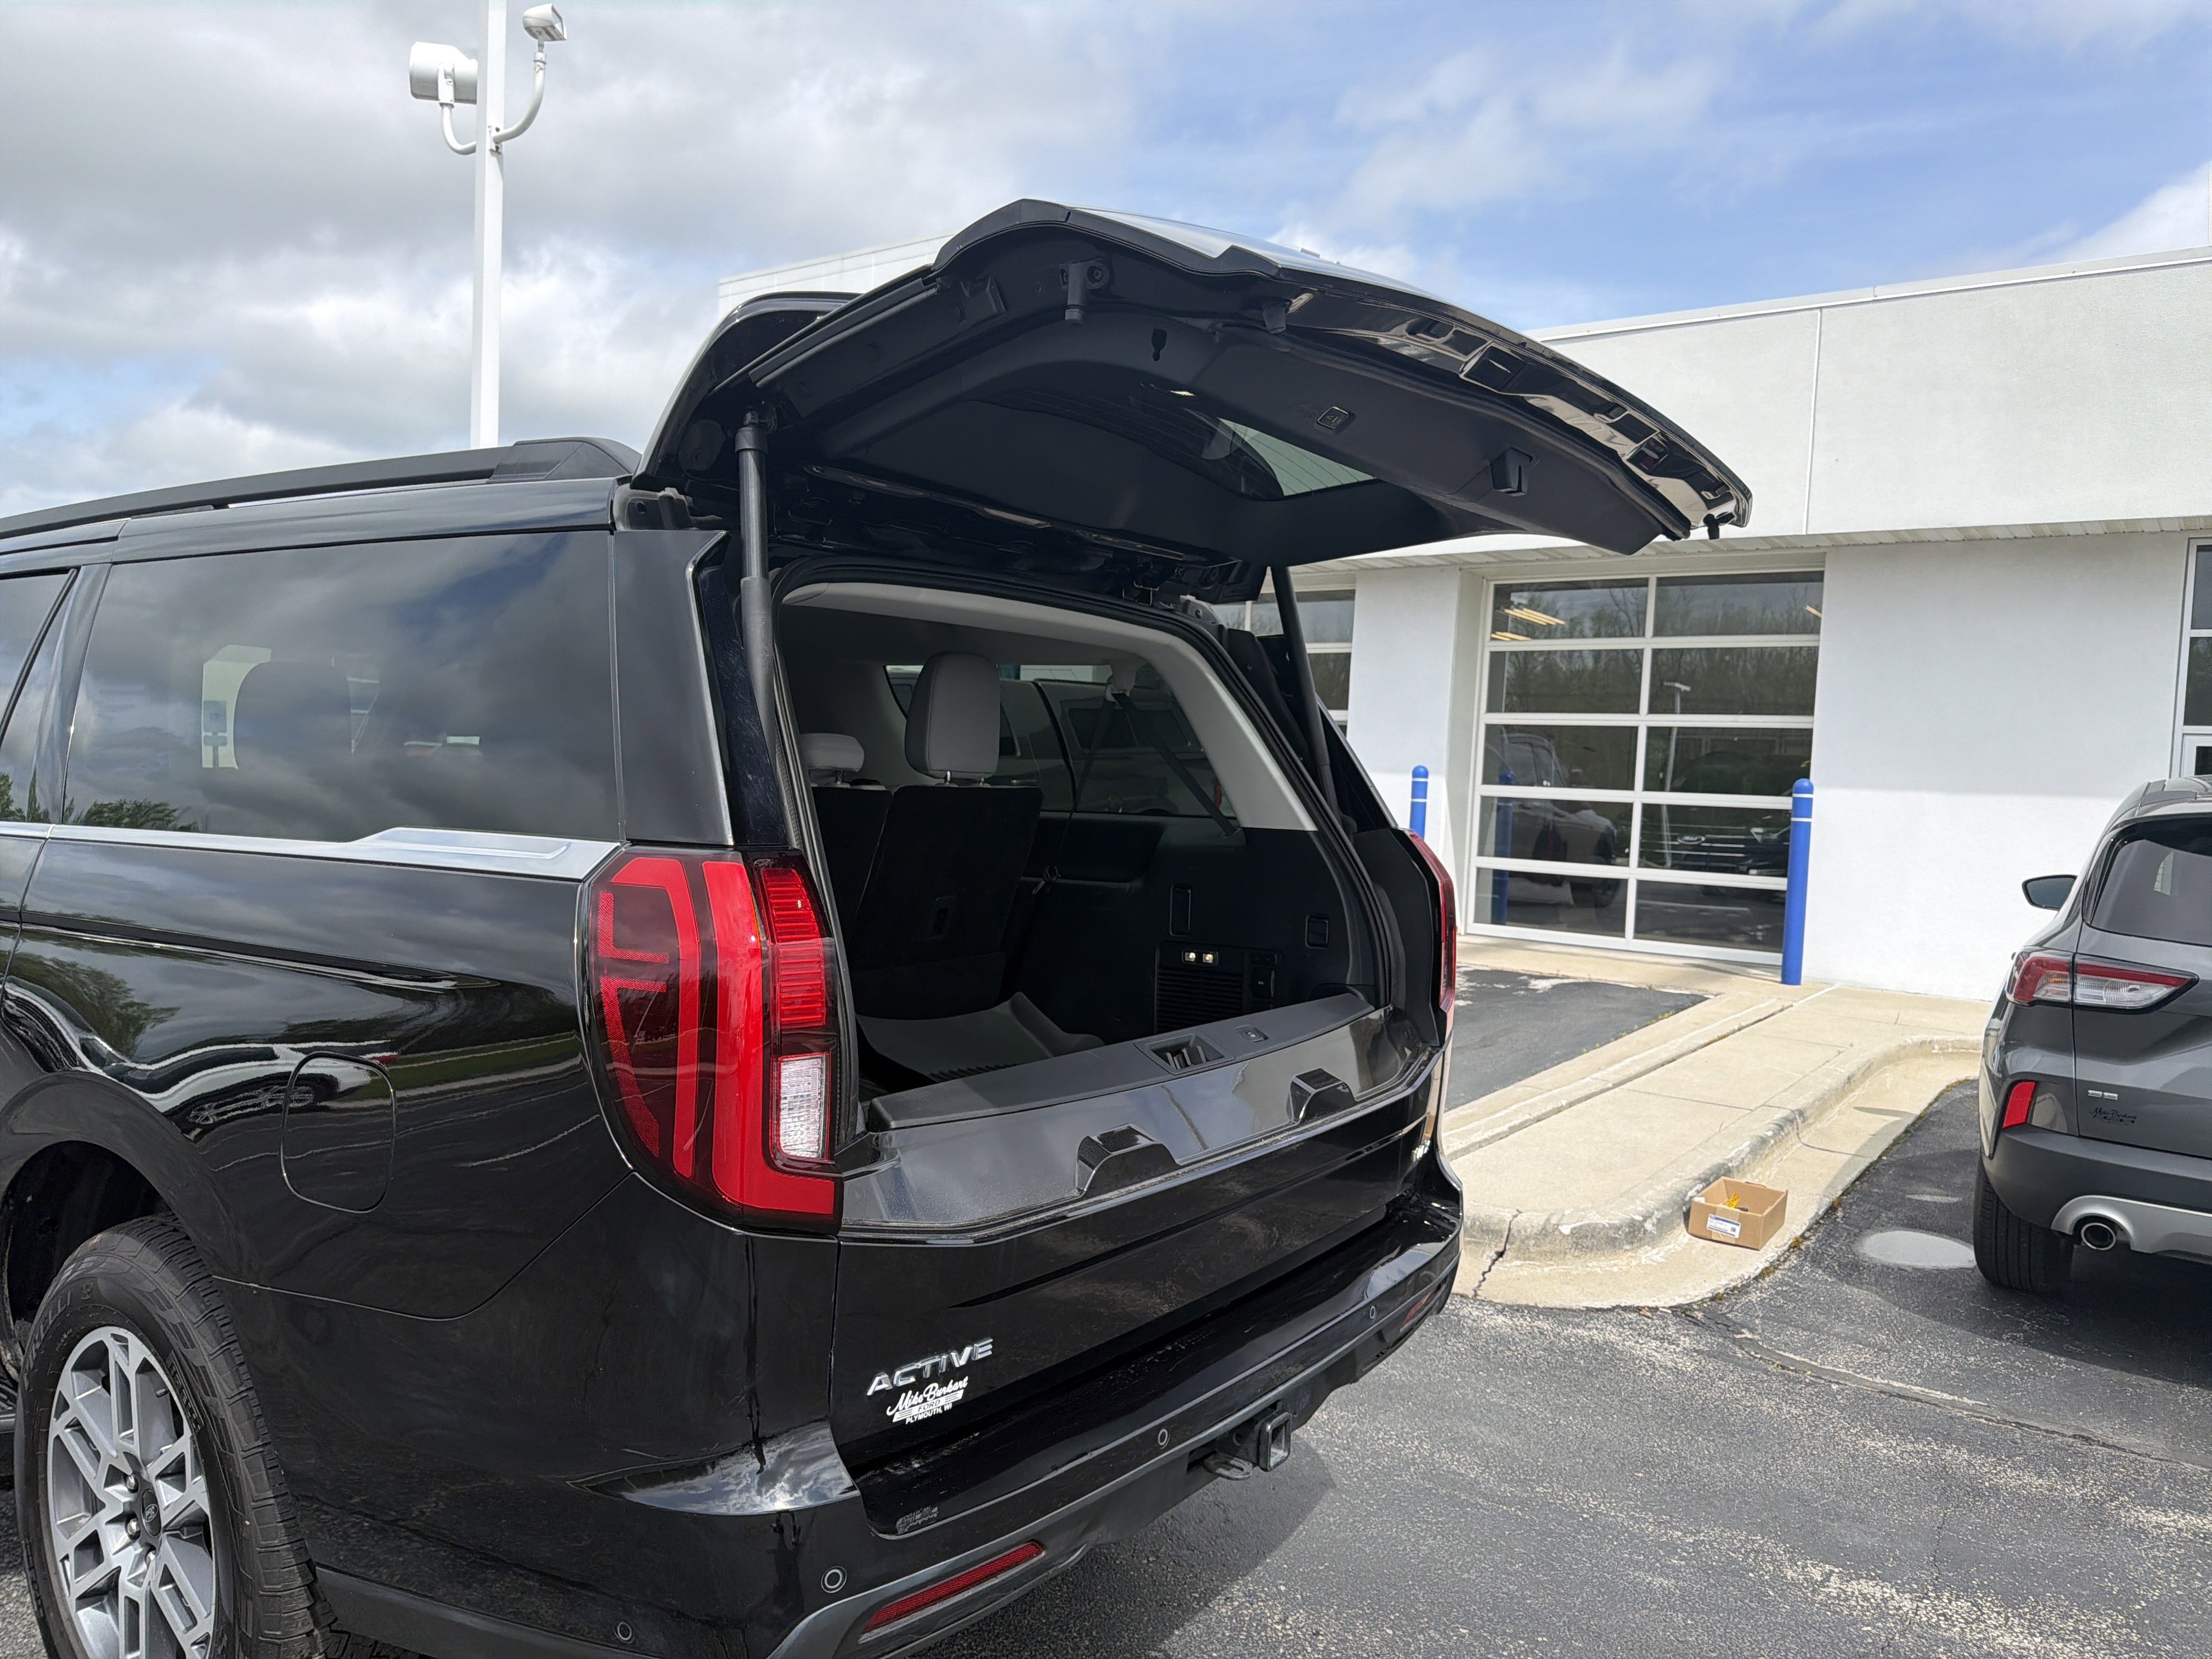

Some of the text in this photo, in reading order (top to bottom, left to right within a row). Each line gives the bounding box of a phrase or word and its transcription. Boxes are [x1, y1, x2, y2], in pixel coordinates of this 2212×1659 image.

[866, 1338, 994, 1396] ACTIVE
[886, 1376, 968, 1416] Mike Burkart
[918, 1400, 940, 1413] FORD
[905, 1403, 952, 1425] PLYMOUTH, WI
